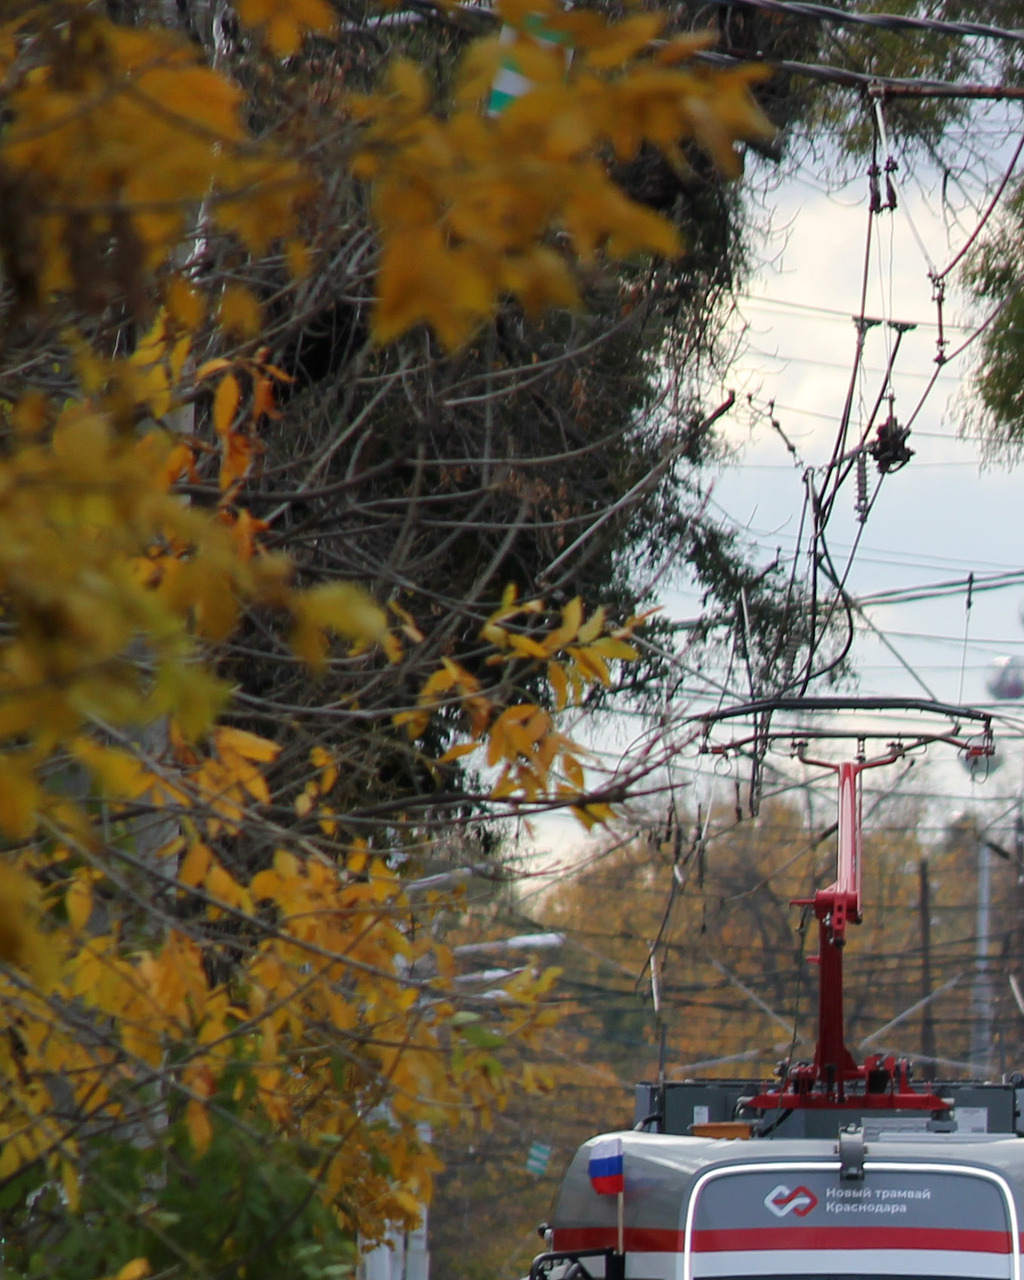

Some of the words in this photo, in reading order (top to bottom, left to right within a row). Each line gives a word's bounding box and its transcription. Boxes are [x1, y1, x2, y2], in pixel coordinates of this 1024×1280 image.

[826, 1187, 871, 1199] Новый
[876, 1188, 931, 1200] трамвай
[826, 1202, 907, 1214] Краснодара
